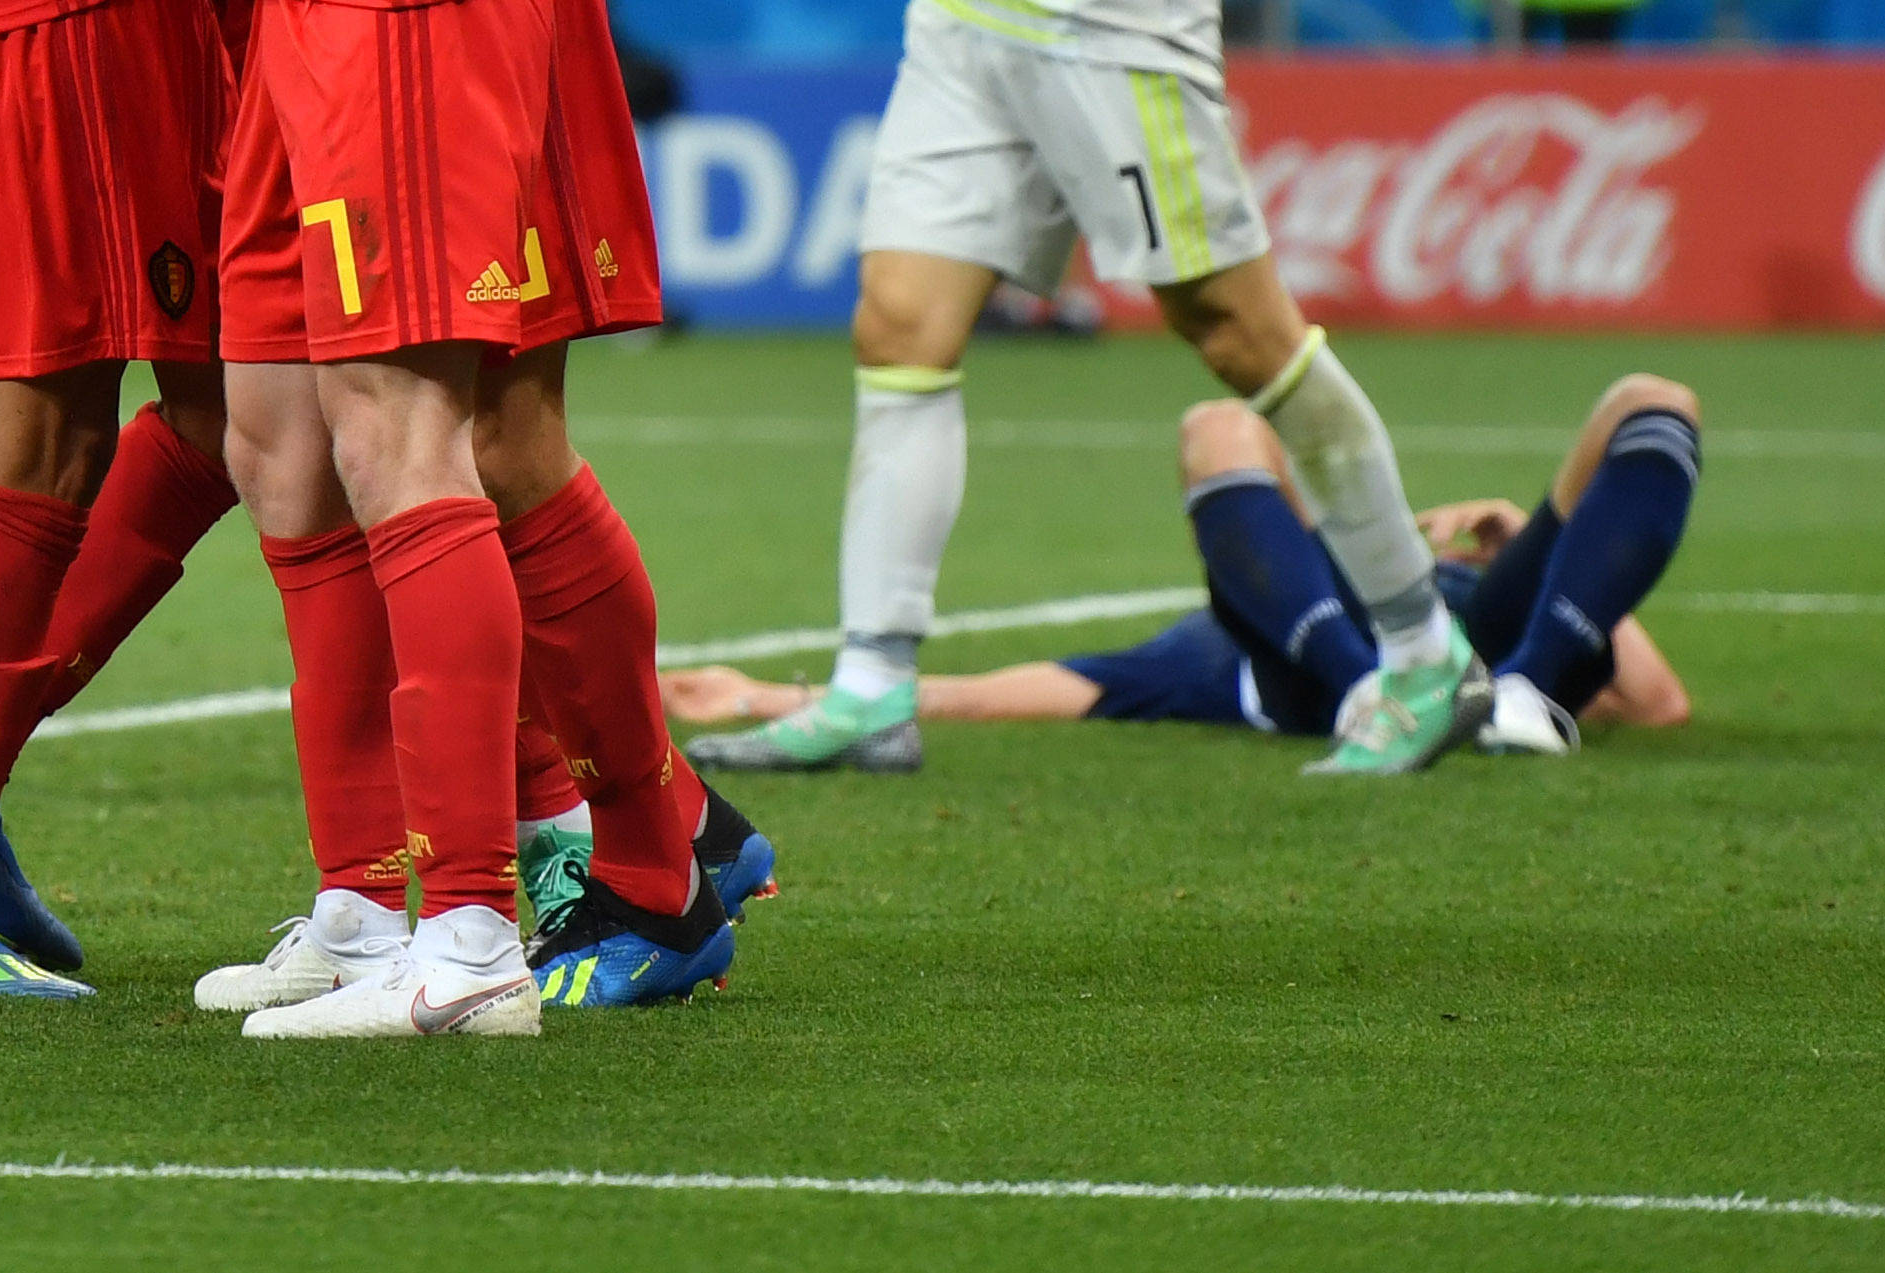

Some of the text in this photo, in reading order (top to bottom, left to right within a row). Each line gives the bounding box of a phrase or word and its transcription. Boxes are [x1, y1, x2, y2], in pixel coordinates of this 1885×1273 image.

[1119, 164, 1161, 250] 1
[302, 198, 362, 315] 7
[466, 286, 520, 302] adidas
